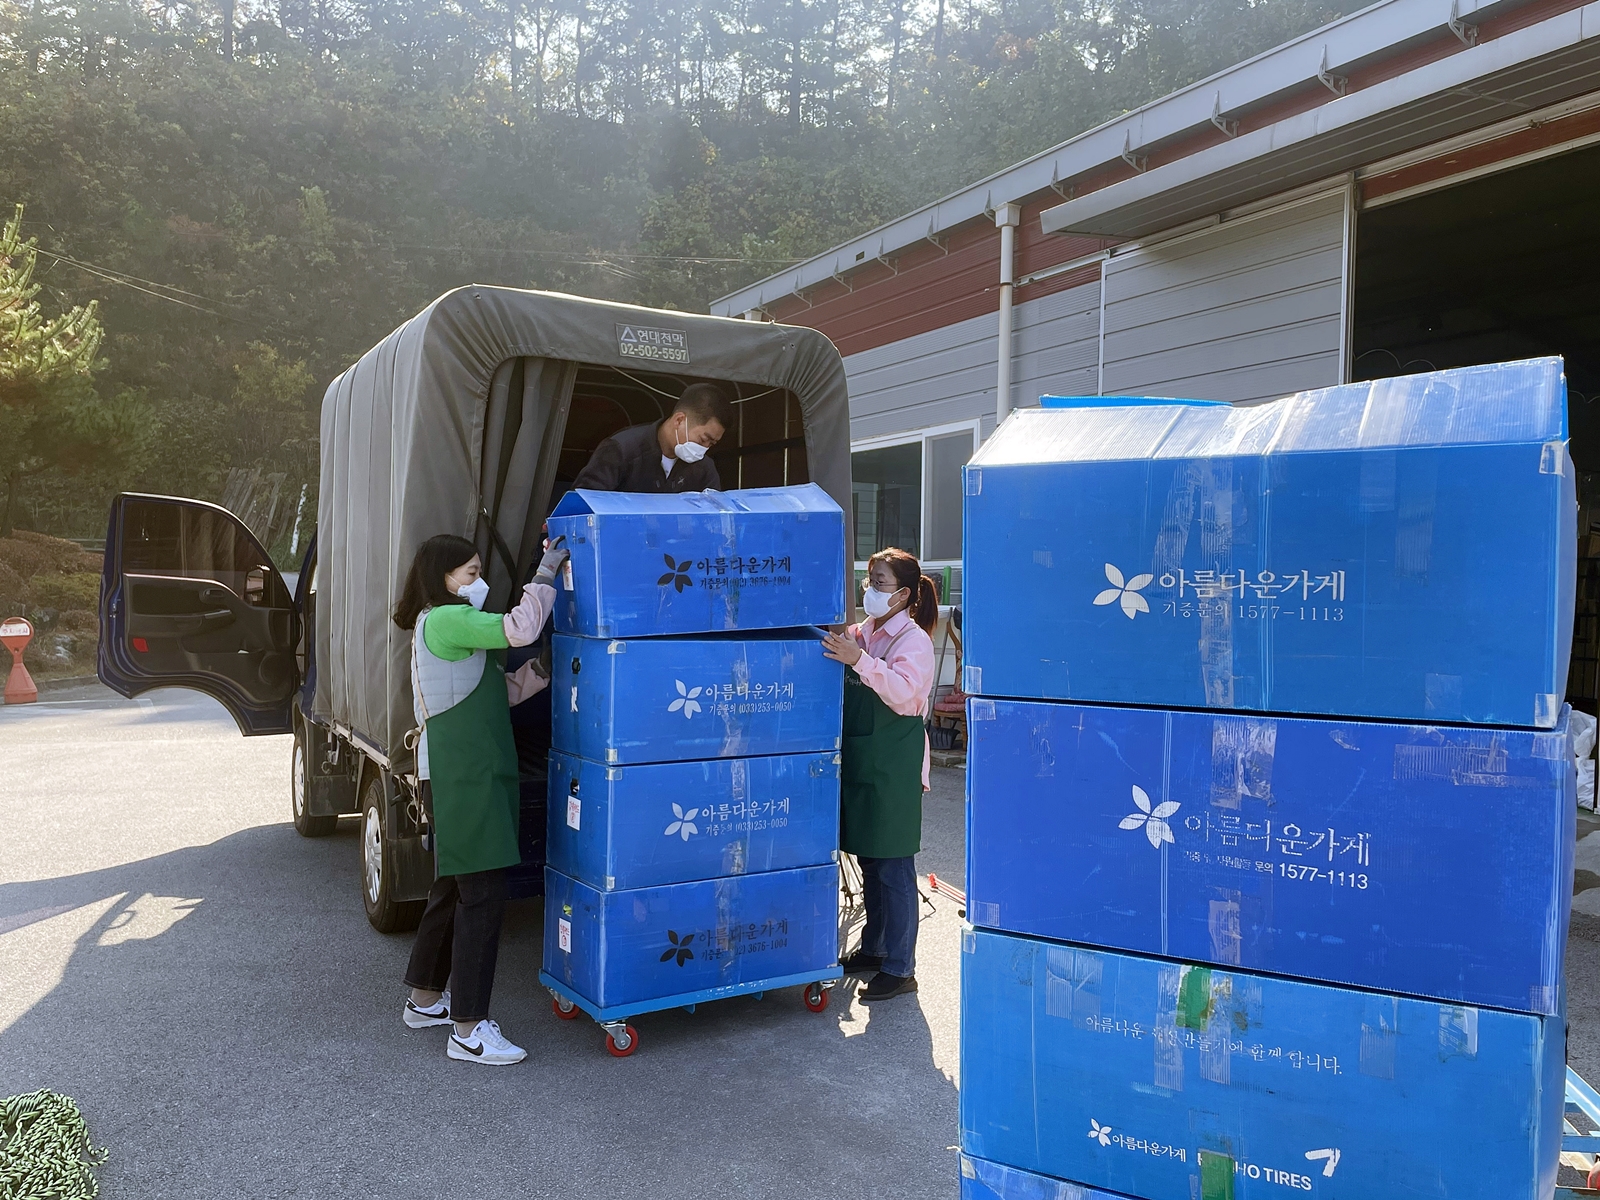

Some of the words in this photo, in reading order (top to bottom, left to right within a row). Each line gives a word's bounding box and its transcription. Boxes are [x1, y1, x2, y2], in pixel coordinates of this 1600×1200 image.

[620, 342, 687, 360] 02-502-5597
[697, 555, 791, 575] 아름다운가게
[700, 578, 729, 589] 기증문의
[750, 576, 791, 586] 3676-1004
[1158, 569, 1346, 602] 아름다운가게
[1163, 603, 1229, 619] 기증문의
[1239, 605, 1344, 621] 1577-1113
[705, 681, 794, 701] 아름다운가게
[739, 702, 791, 714] (033)253-0050
[702, 797, 790, 822] 아름다운가게
[735, 817, 788, 832] (033)253-0050
[1255, 860, 1274, 874] 문의
[1279, 863, 1369, 890] 1577-1113
[699, 918, 788, 946] 아름다운가게
[702, 948, 730, 961] 기증문
[748, 938, 788, 953] 3676-1004
[1086, 1015, 1144, 1039] 아름다운
[1289, 1050, 1343, 1075] 합니다.
[1112, 1133, 1186, 1163] 아름다운가게
[1263, 1167, 1312, 1191] TIRES
